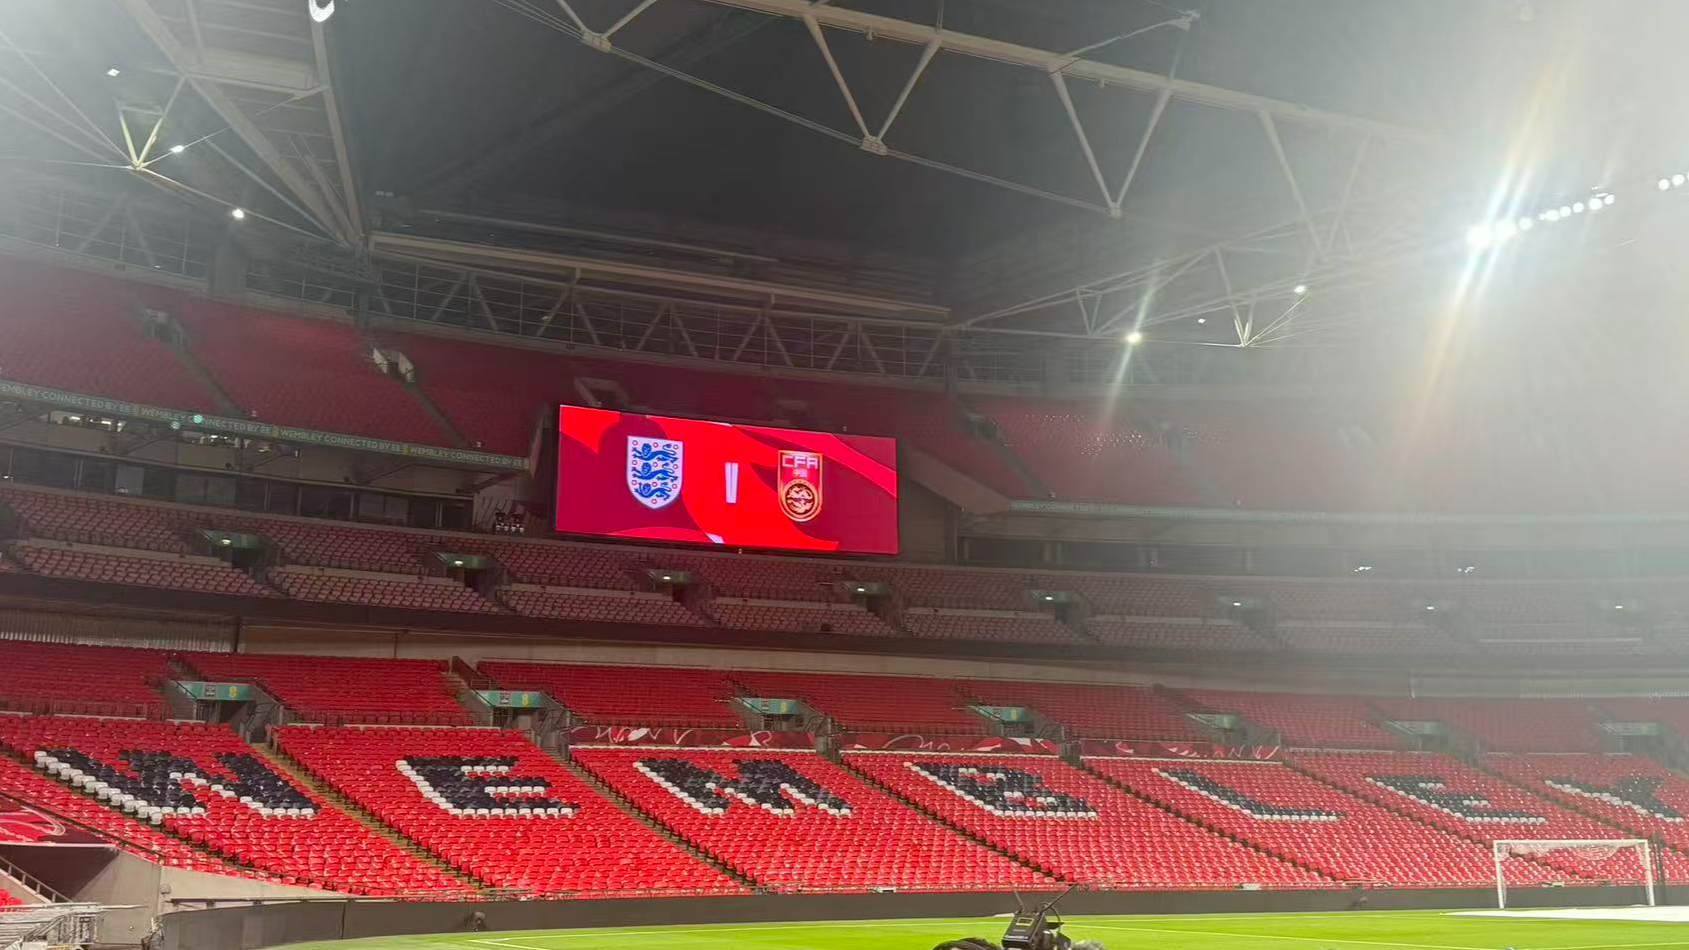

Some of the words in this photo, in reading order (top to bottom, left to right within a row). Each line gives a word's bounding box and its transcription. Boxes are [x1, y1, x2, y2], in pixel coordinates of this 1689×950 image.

[0, 382, 41, 398] EMBLEY
[41, 391, 105, 409] CONNECTED
[105, 402, 119, 411] BY
[119, 404, 132, 413] EE
[141, 407, 187, 421] WEMBLEY
[247, 424, 261, 433] BY
[281, 428, 322, 442] WEMBLEY
[323, 434, 378, 449] CONNECTED
[379, 443, 392, 451] BY
[410, 446, 450, 459] WEMBLEY
[450, 451, 501, 465] CONNECTED
[782, 455, 818, 469] CFA
